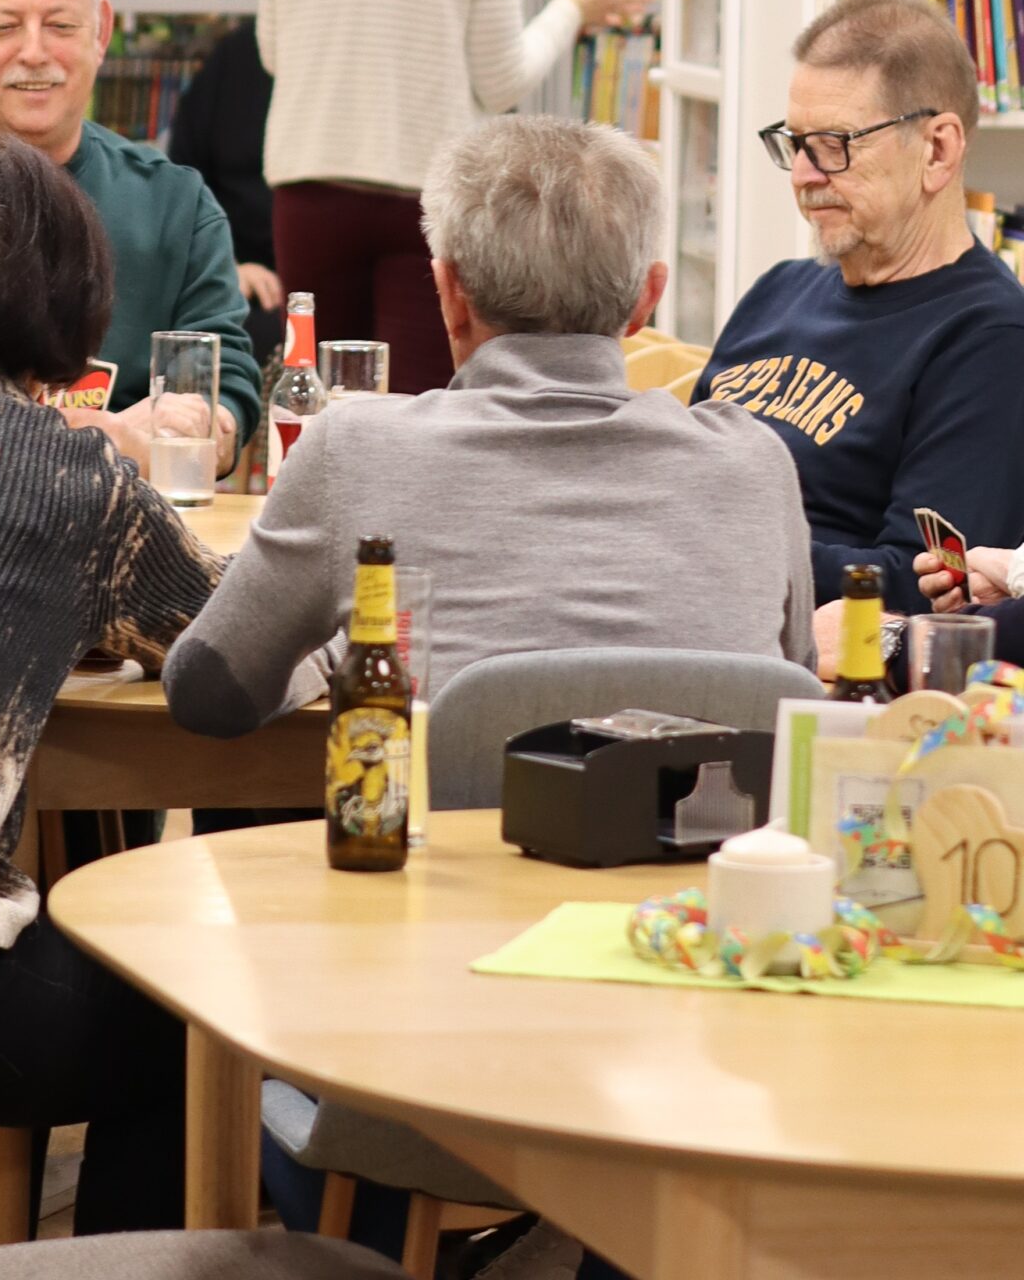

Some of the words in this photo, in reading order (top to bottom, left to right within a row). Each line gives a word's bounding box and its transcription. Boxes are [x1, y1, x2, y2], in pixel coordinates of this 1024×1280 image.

[64, 387, 107, 408] UNO
[710, 354, 793, 413] PEPE
[763, 357, 865, 447] JEANS
[940, 837, 1021, 919] 10
